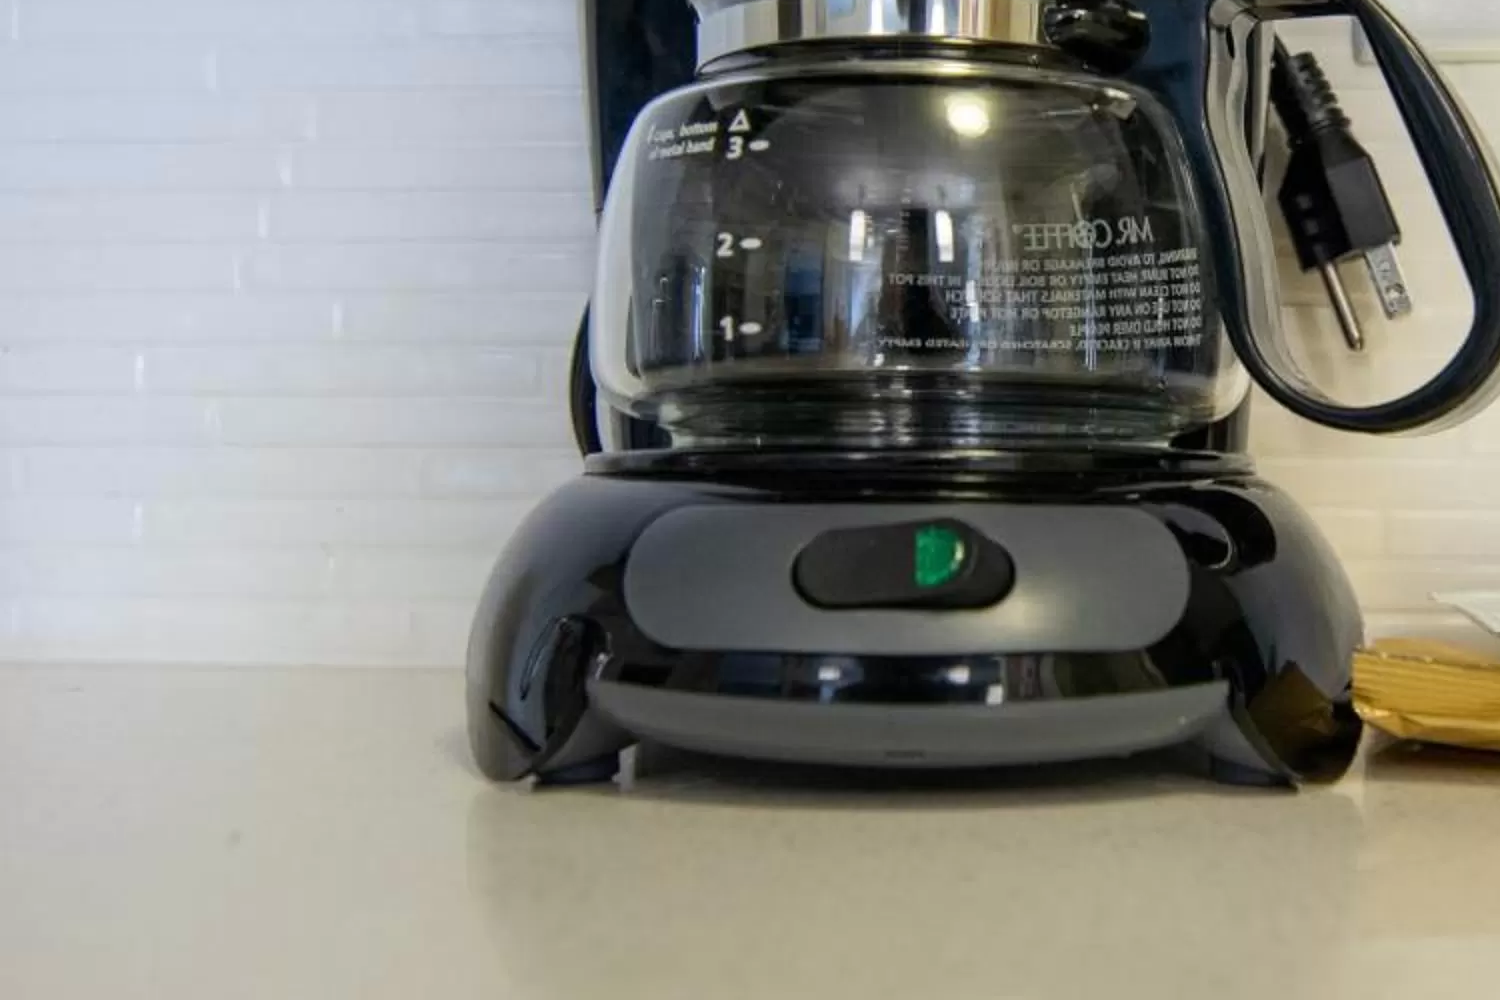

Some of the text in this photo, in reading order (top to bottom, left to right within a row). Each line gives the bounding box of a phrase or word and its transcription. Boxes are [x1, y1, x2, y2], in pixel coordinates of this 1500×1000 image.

[679, 121, 718, 137] bottom
[686, 137, 715, 153] band
[726, 136, 744, 159] 3
[717, 232, 735, 257] 2
[719, 316, 734, 341] 1
